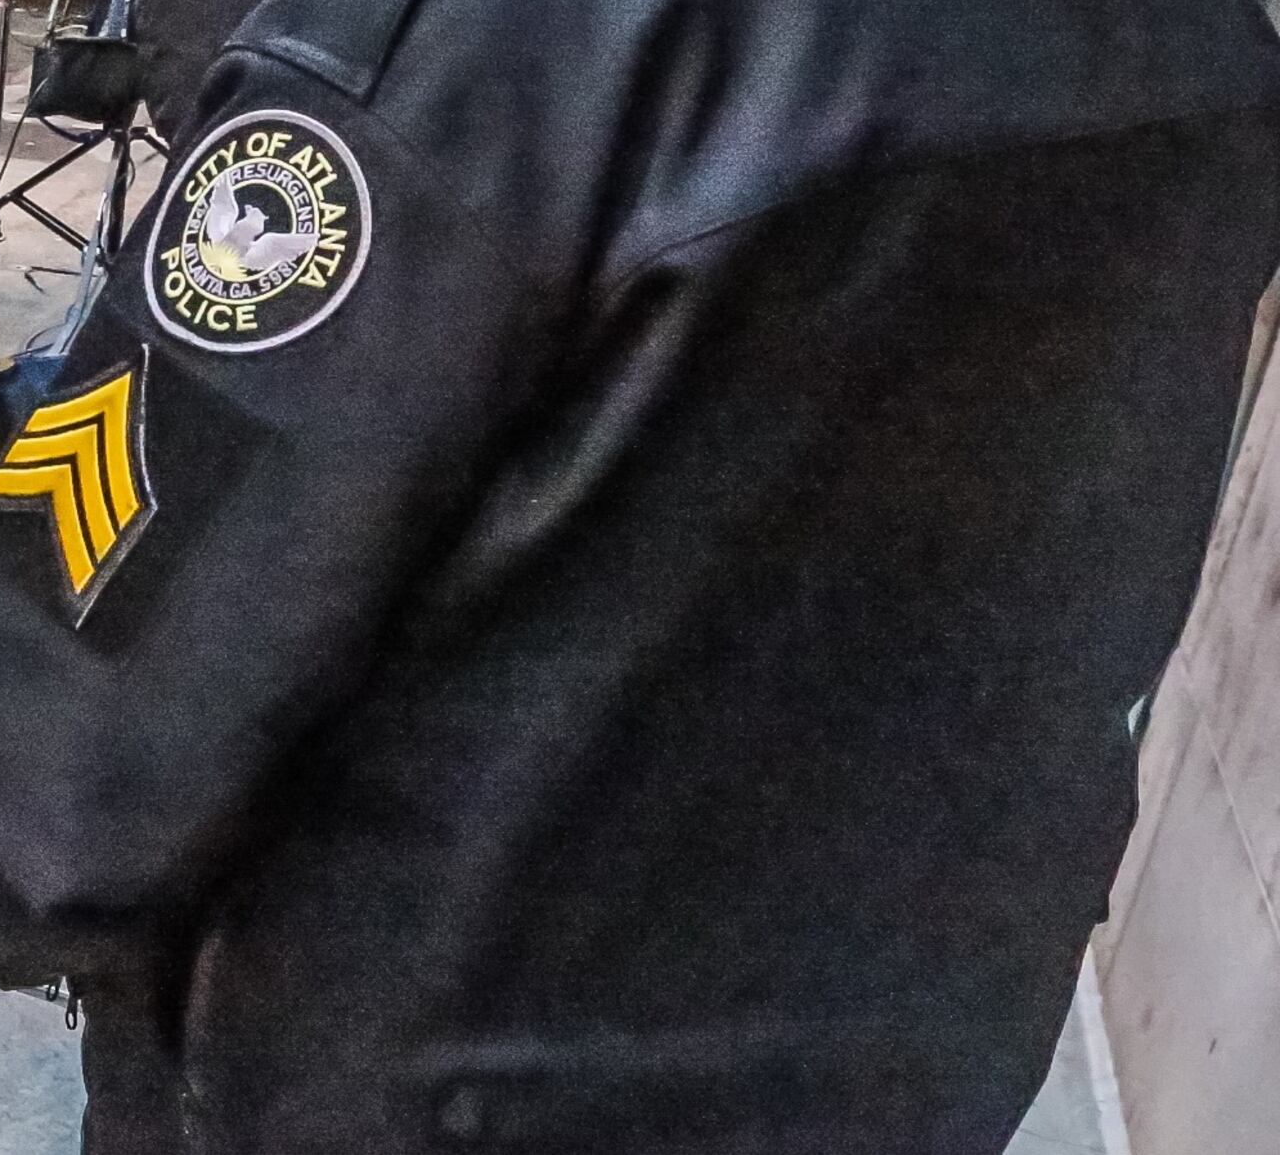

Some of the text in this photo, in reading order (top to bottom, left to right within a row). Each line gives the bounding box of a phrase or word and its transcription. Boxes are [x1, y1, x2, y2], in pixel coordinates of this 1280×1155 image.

[184, 132, 348, 289] CITY OF ATLANTA
[231, 163, 314, 234] RESURGENS
[161, 246, 259, 332] POLICE
